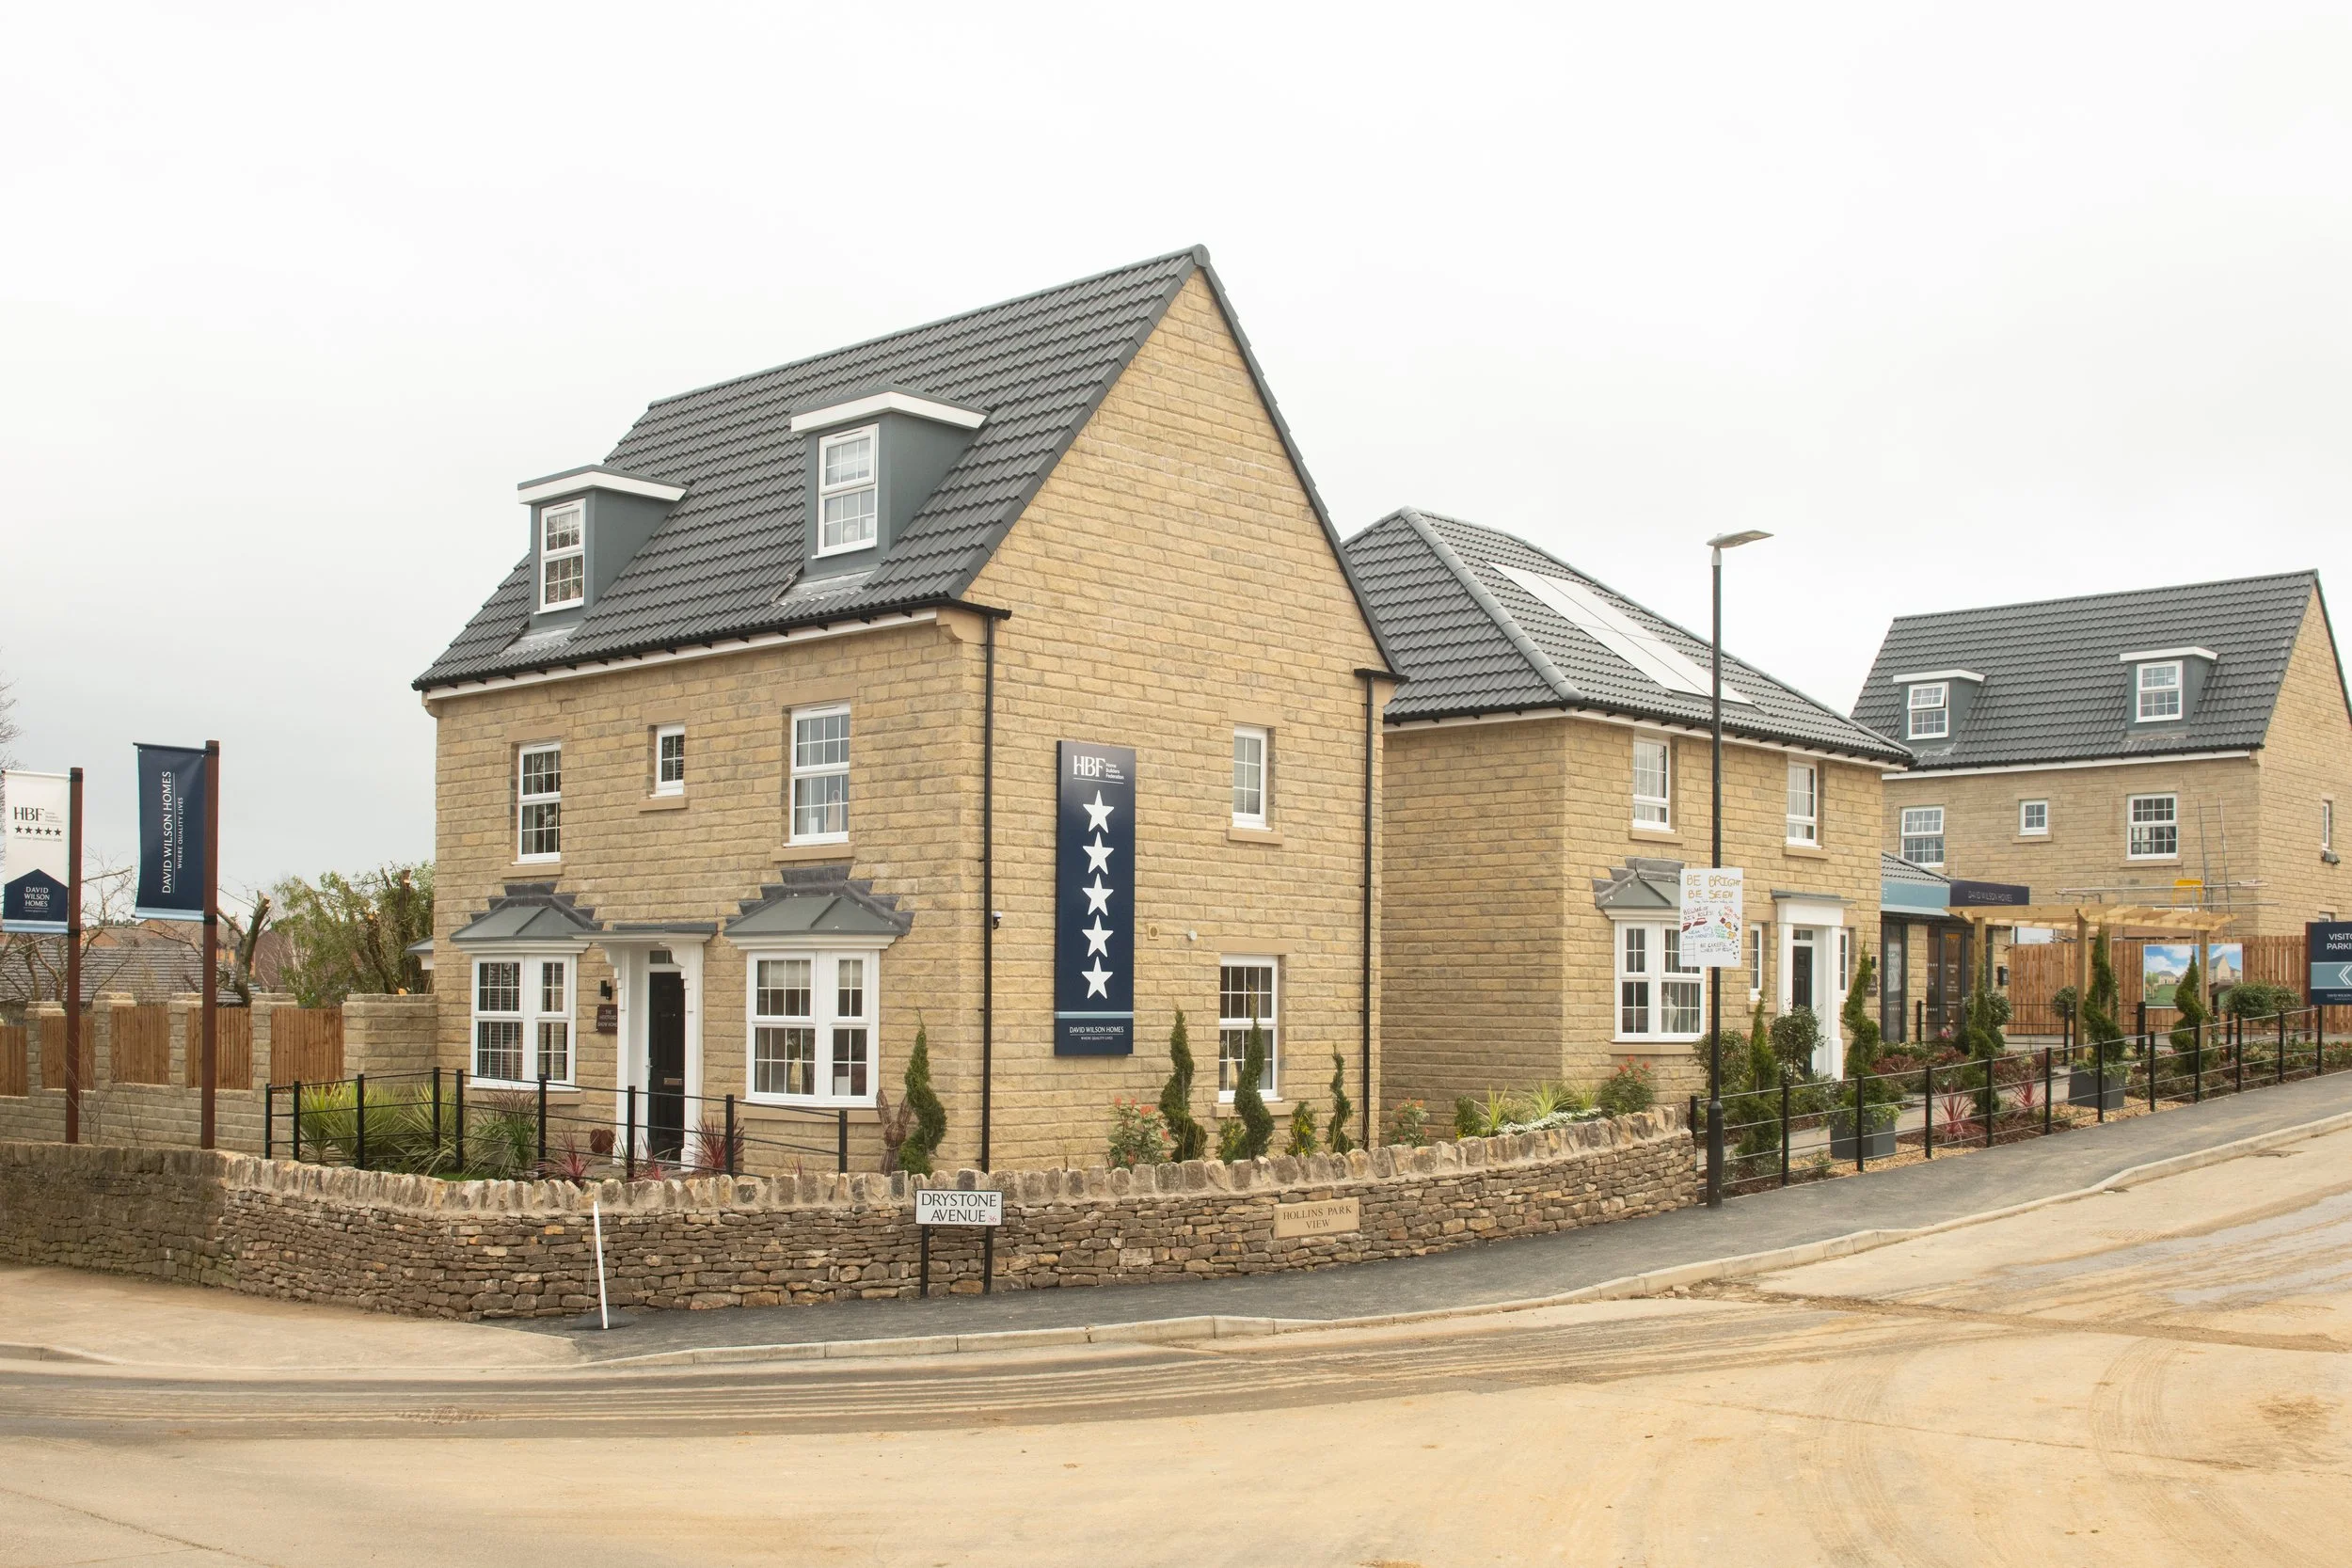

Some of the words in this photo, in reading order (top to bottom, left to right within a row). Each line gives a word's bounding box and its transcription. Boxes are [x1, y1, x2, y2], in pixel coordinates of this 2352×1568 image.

[1073, 755, 1105, 777] HBF
[162, 771, 172, 811] HOMES
[14, 806, 44, 821] HBF
[163, 814, 173, 857] WILSON
[162, 860, 172, 894] DAVID
[1686, 874, 1702, 886] BE
[1688, 890, 1703, 899] BE
[1708, 890, 1734, 899] SEEN
[921, 1193, 996, 1207] DRYSTONE
[930, 1209, 986, 1223] AVENUE
[1283, 1208, 1324, 1220] HOLLINS
[1327, 1205, 1352, 1216] PARK
[1306, 1218, 1330, 1229] VIEW
